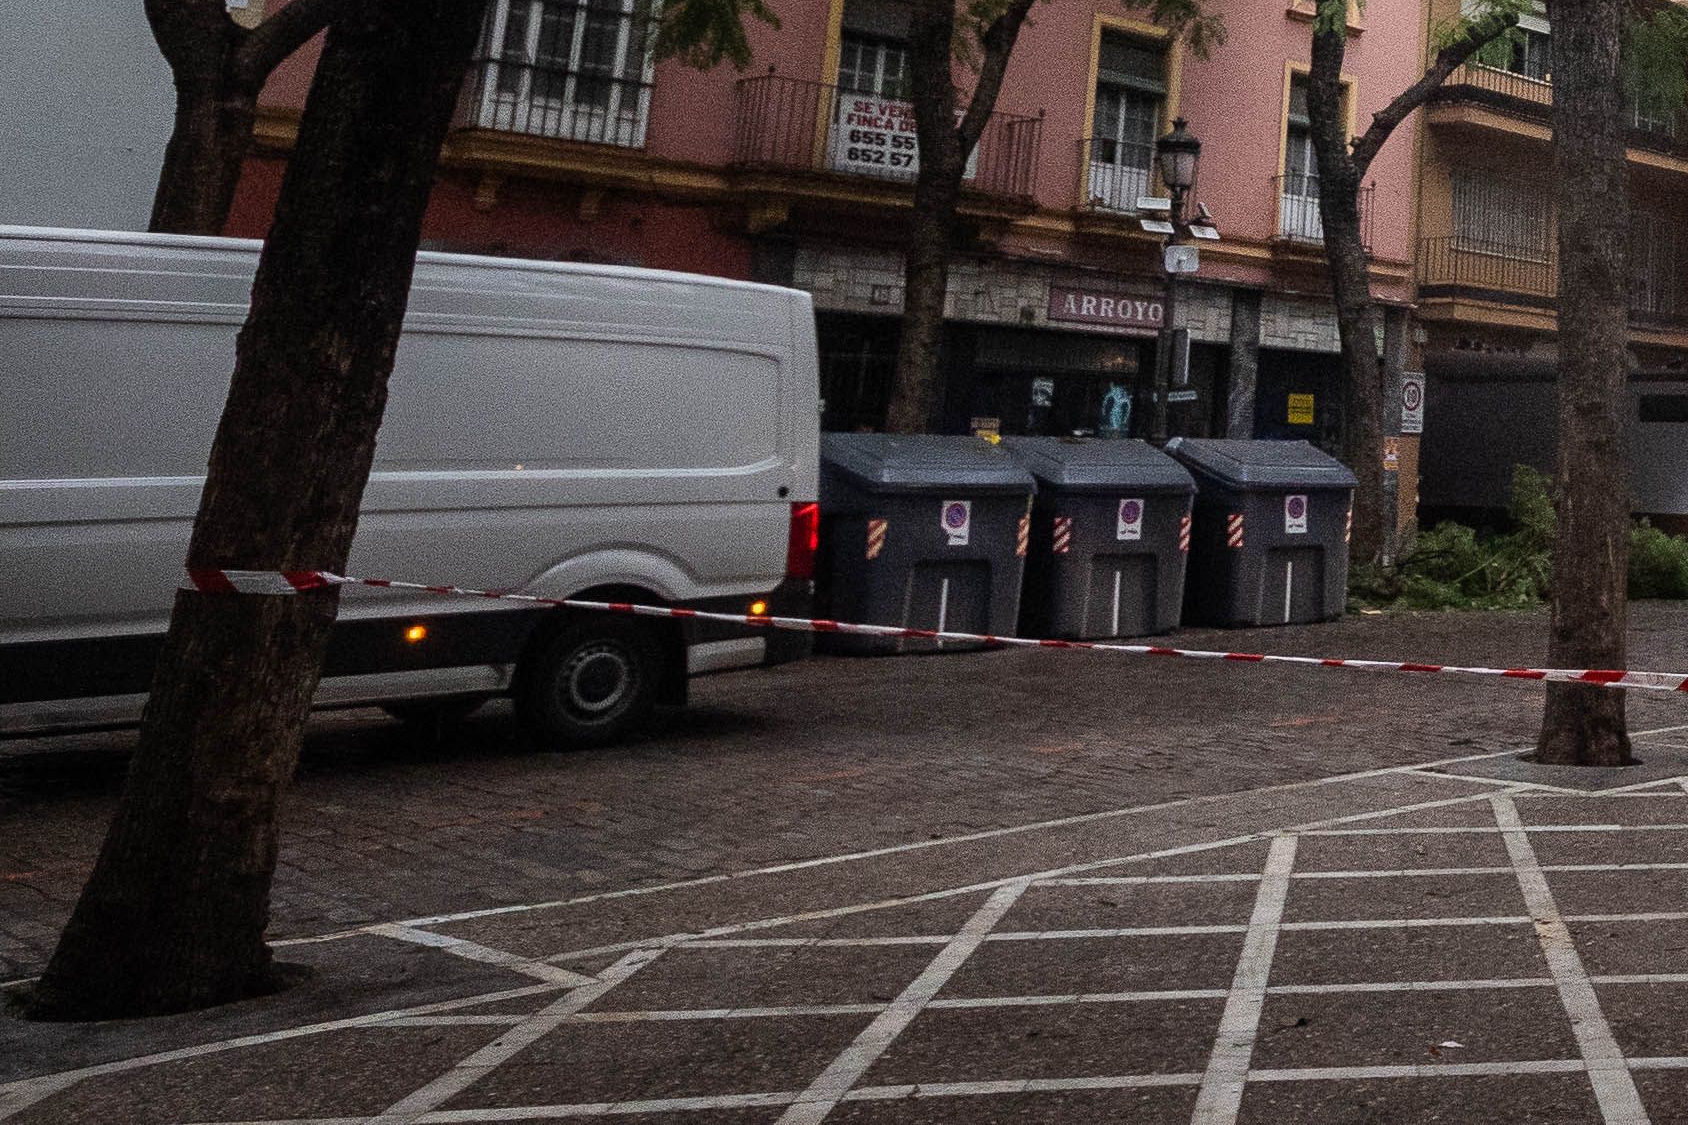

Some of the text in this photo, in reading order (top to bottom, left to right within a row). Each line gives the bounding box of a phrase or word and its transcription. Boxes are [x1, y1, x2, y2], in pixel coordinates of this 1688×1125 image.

[853, 100, 874, 114] SE
[847, 113, 895, 131] FINCA
[849, 129, 916, 151] 655 55
[848, 147, 914, 168] 652 57
[1063, 294, 1164, 322] ARROYO
